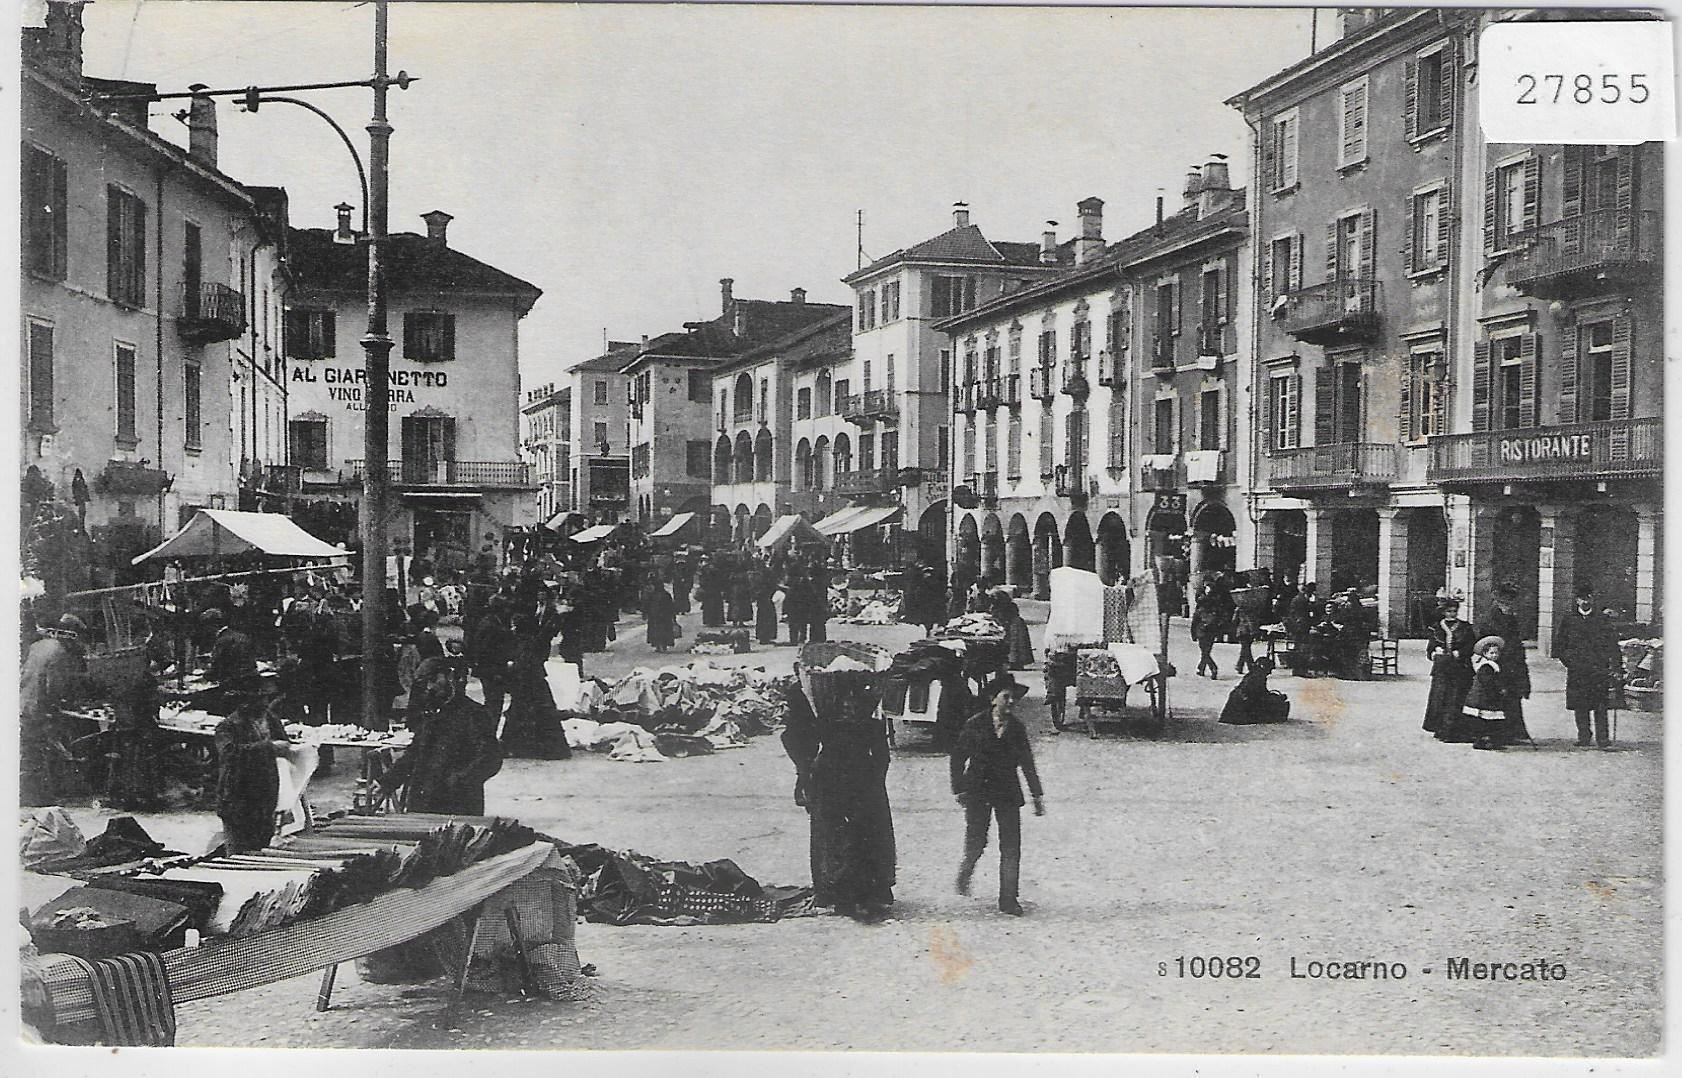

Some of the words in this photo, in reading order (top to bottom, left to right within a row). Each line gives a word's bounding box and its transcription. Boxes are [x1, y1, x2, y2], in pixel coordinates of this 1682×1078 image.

[1516, 73, 1649, 105] 27855
[292, 366, 317, 383] AL
[324, 368, 448, 388] GIARNETTO
[328, 387, 361, 401] VINO
[1500, 435, 1590, 461] RISTORANTE
